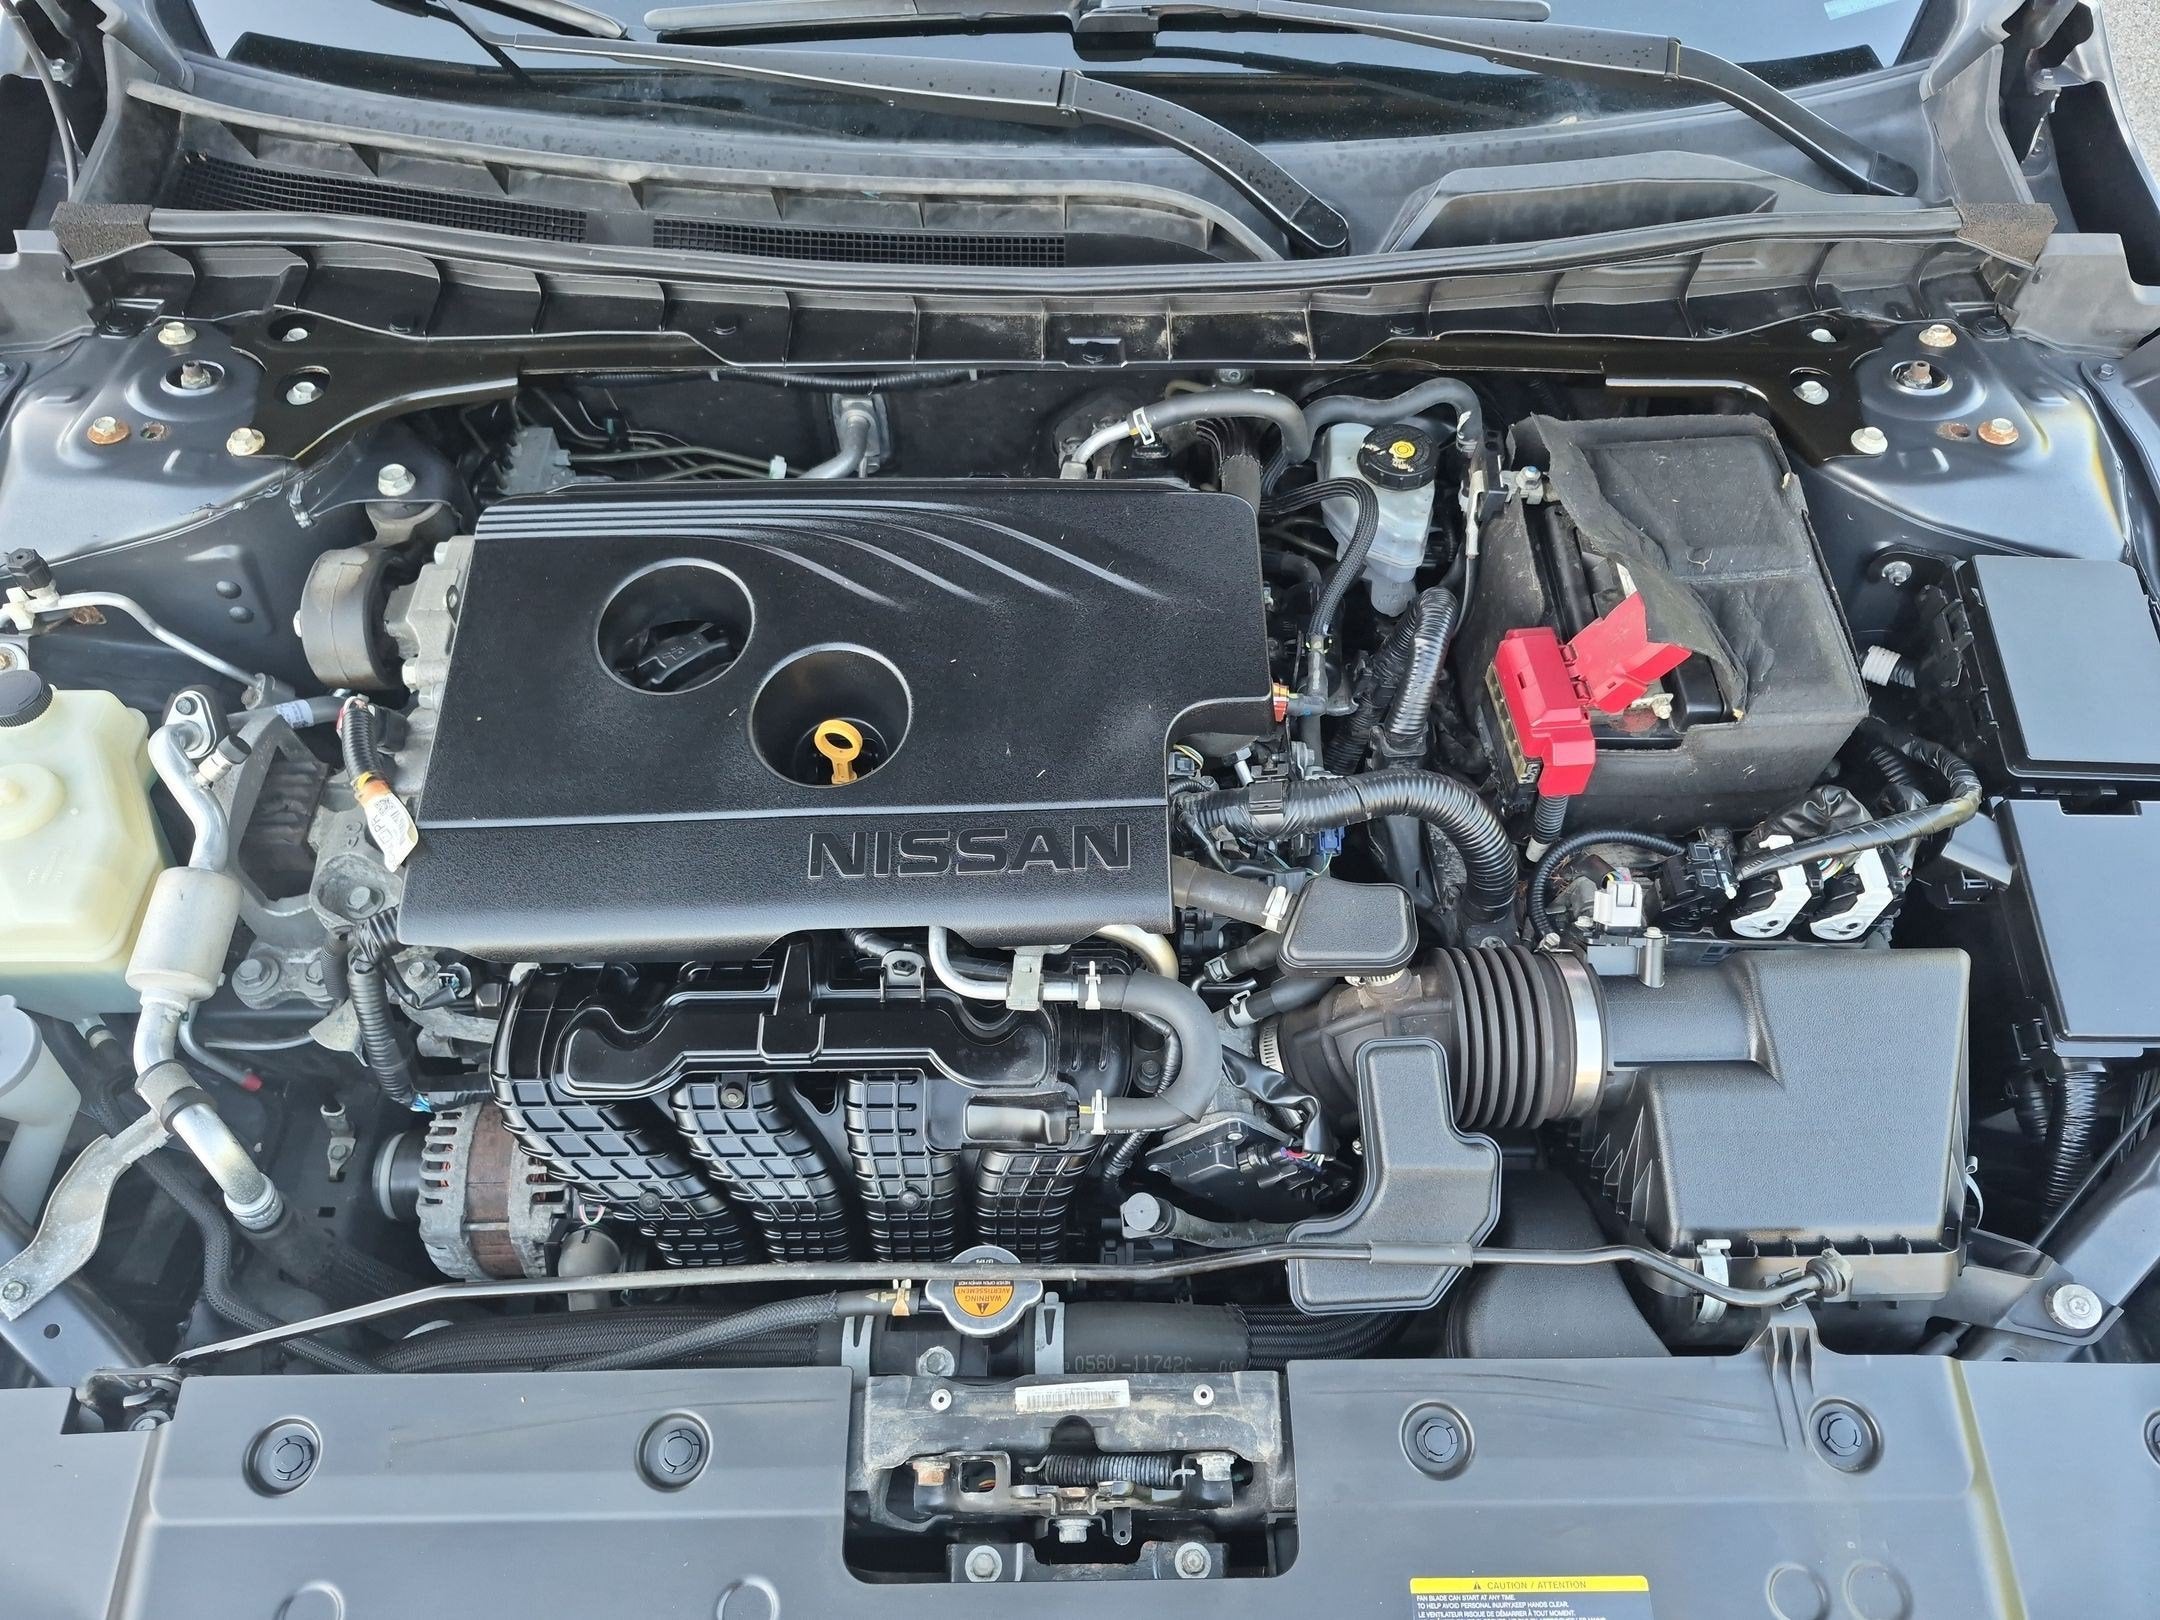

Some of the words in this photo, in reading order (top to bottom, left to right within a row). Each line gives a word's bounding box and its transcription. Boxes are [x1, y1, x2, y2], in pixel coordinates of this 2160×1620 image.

[808, 823, 1130, 878] NISSAN
[957, 1287, 1010, 1295] AVERTISSEMENT
[1487, 1581, 1528, 1590] CAUTION
[1537, 1580, 1587, 1589] ATTENTION
[1495, 1609, 1527, 1617] DÉMARRER
